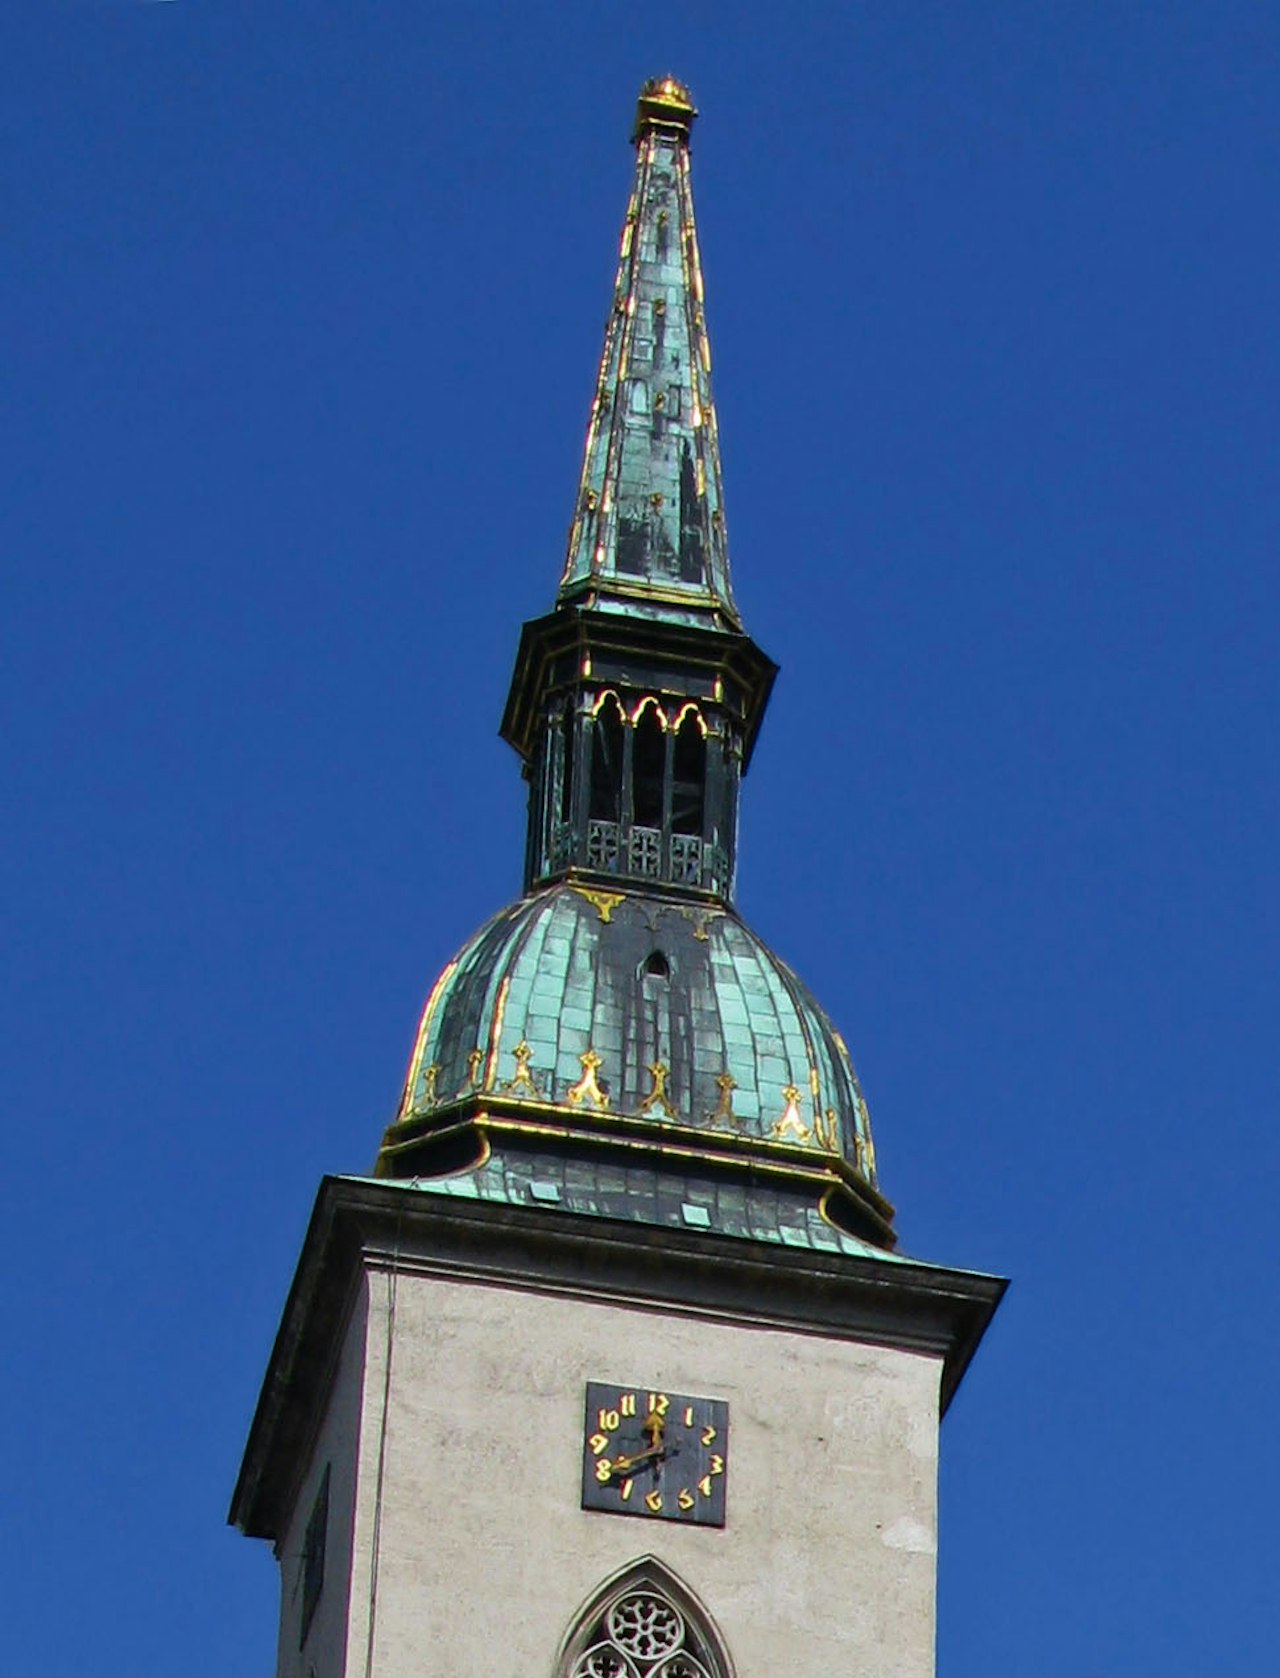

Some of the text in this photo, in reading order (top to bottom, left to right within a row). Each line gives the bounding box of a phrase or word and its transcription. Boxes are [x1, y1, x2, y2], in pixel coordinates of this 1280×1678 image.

[620, 1394, 635, 1416] 11
[649, 1394, 670, 1416] 12
[599, 1408, 619, 1430] 10
[686, 1407, 693, 1426] 1
[589, 1434, 608, 1455] 9
[702, 1426, 716, 1446] 2
[596, 1458, 611, 1481] 8
[710, 1454, 723, 1474] 3
[698, 1475, 711, 1496] 4
[646, 1489, 662, 1511] 6
[679, 1488, 694, 1509] 5
